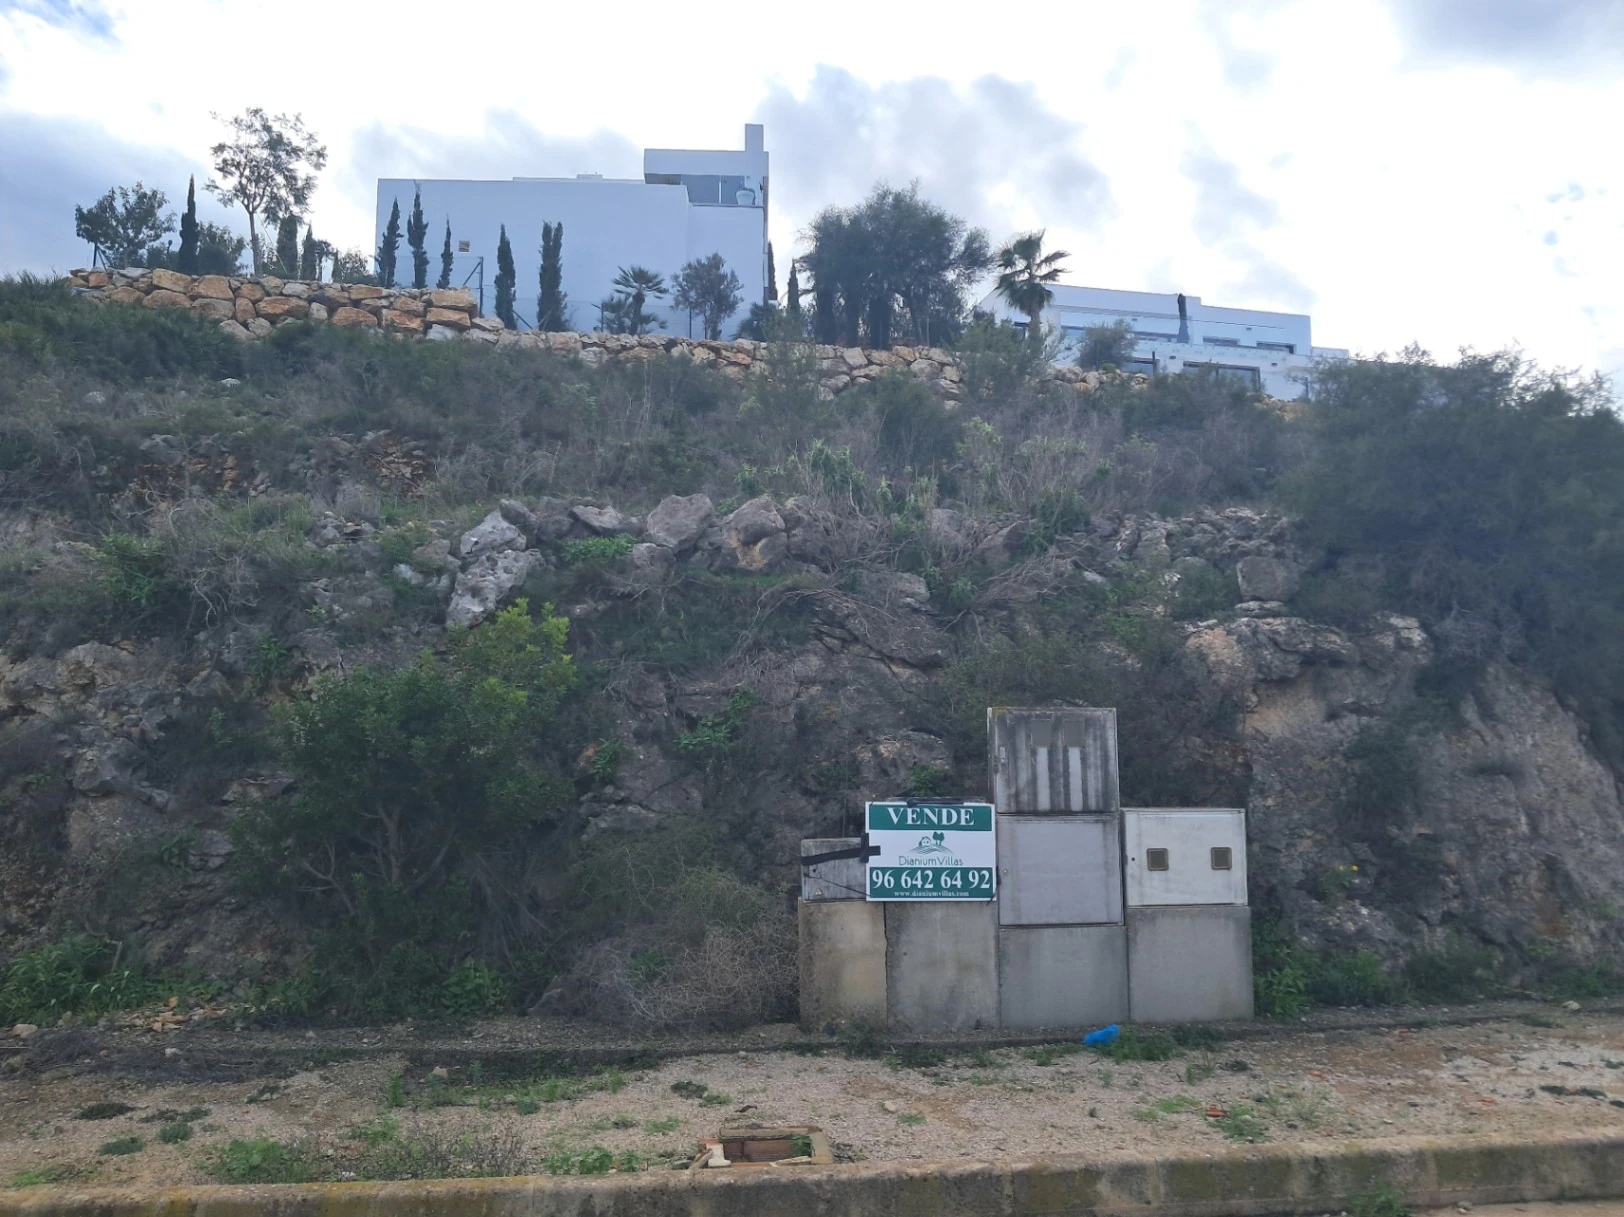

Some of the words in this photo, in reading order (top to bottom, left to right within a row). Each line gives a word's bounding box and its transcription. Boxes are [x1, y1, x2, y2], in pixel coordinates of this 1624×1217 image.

[887, 807, 975, 826] VENDE
[872, 869, 895, 889] 96
[900, 869, 934, 889] 642
[940, 869, 962, 889] 64
[968, 869, 990, 889] 92
